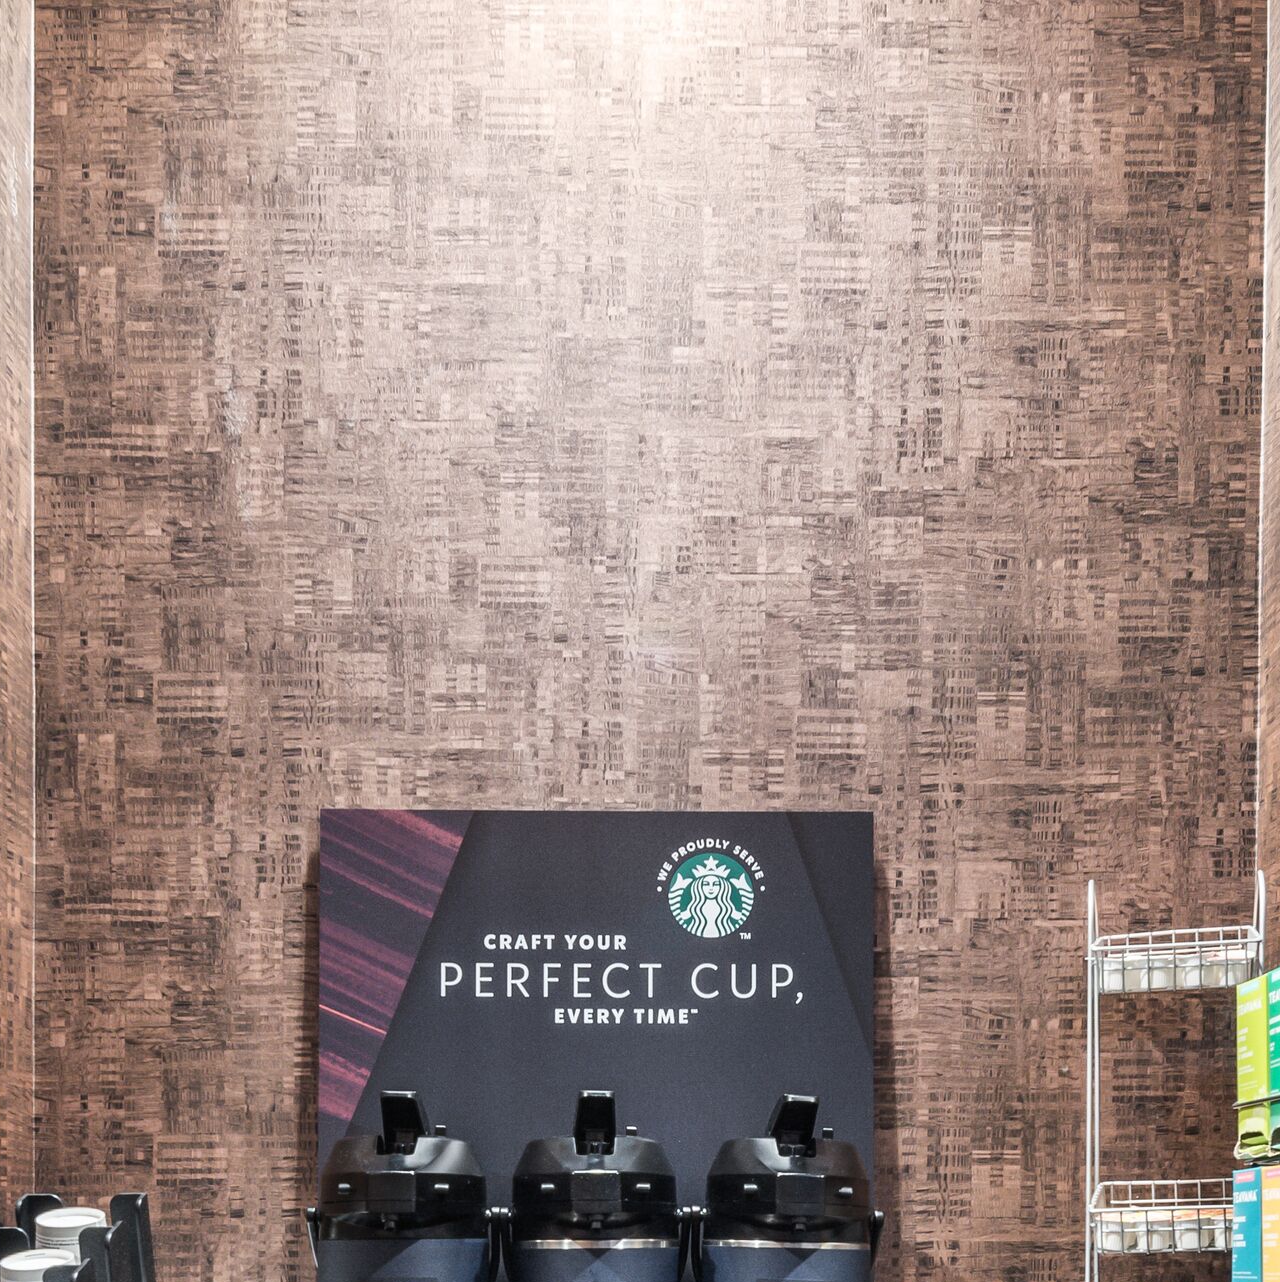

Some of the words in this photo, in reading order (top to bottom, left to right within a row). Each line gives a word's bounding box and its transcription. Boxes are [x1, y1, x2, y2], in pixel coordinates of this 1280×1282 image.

[657, 861, 673, 881] WE
[671, 838, 730, 862] PROUDLY
[733, 845, 765, 880] SERVE
[483, 934, 556, 950] CRAFT
[564, 934, 628, 950] YOUR
[439, 962, 662, 999] PERFECT
[690, 962, 804, 1004] CUP,
[554, 1008, 625, 1025] EVERY
